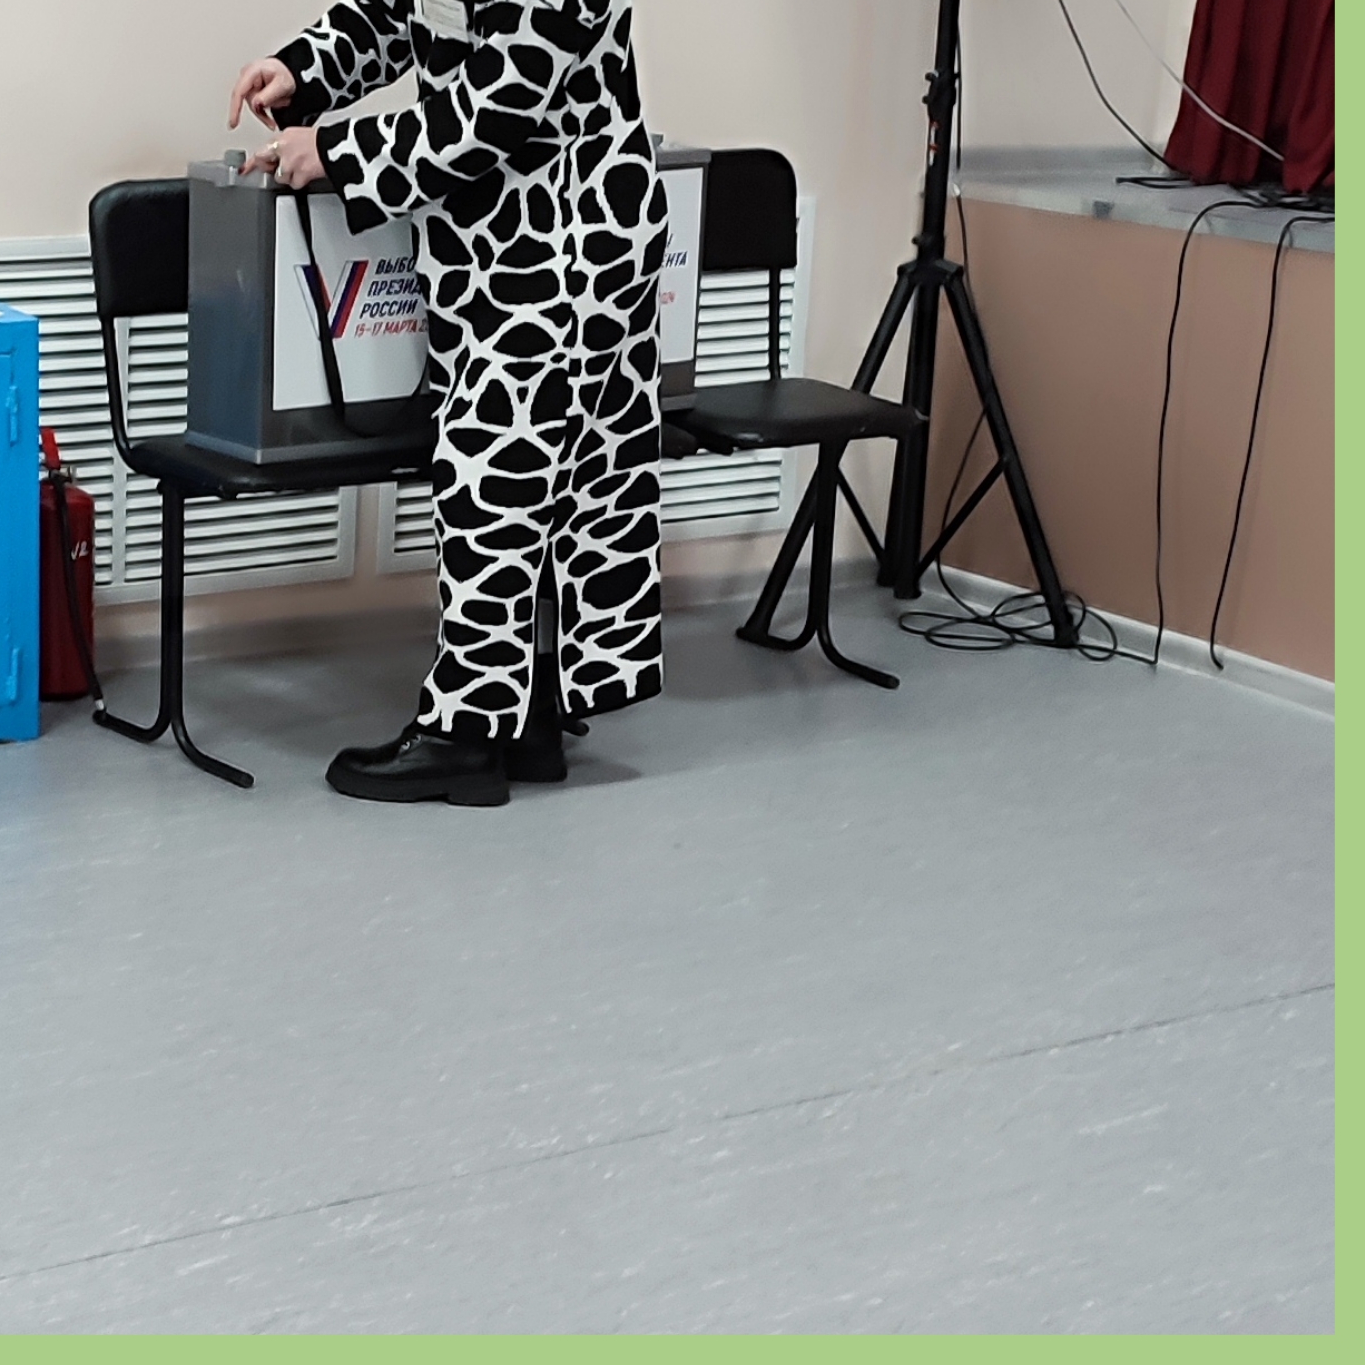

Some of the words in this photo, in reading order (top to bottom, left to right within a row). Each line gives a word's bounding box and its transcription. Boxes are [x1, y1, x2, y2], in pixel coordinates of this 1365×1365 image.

[375, 257, 416, 275] ВЫБО
[367, 278, 421, 297] ПРЕЗИД
[359, 298, 419, 319] РОССИИ
[383, 319, 417, 334] МАРТА
